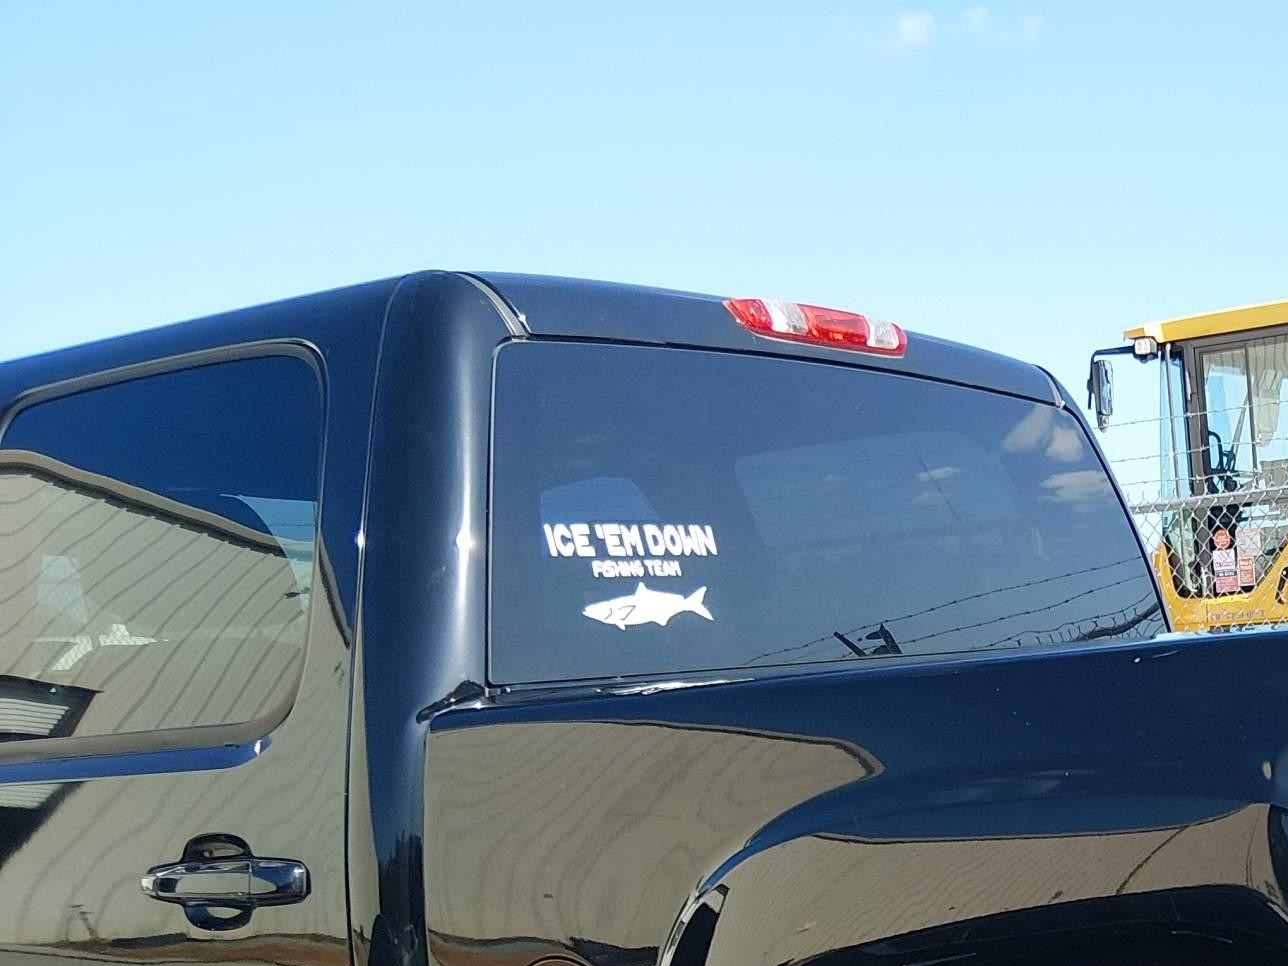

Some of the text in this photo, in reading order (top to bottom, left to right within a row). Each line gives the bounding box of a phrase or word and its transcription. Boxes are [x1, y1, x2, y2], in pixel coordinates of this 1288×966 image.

[543, 523, 718, 557] ICE 'EM DOWN
[591, 559, 683, 578] FISHING TEAM
